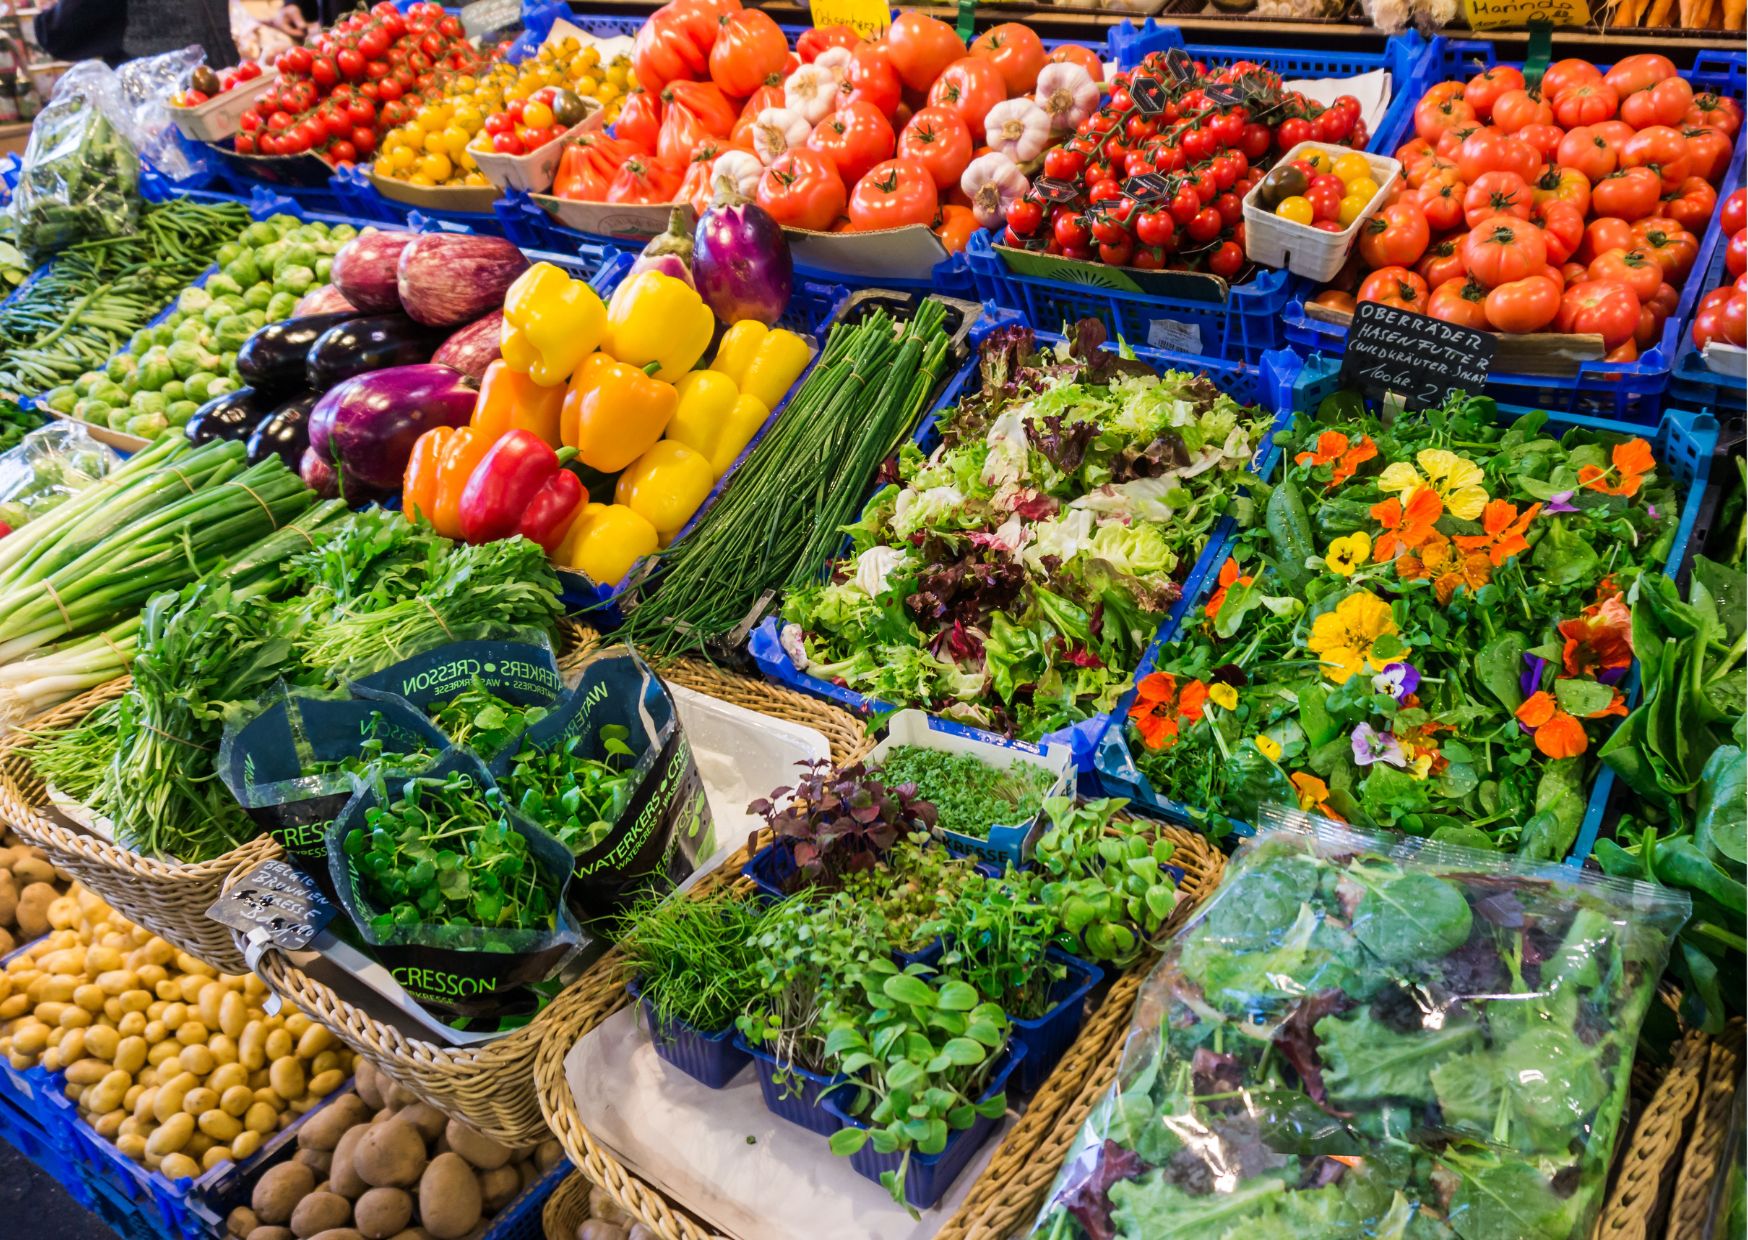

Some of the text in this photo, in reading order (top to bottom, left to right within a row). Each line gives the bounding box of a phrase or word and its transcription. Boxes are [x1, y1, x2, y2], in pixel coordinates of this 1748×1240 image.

[1361, 304, 1482, 350] OBERRÄDER
[573, 790, 660, 880] WATERKERS
[615, 817, 658, 871] WATERCRESS
[391, 966, 497, 997] CRESSON
